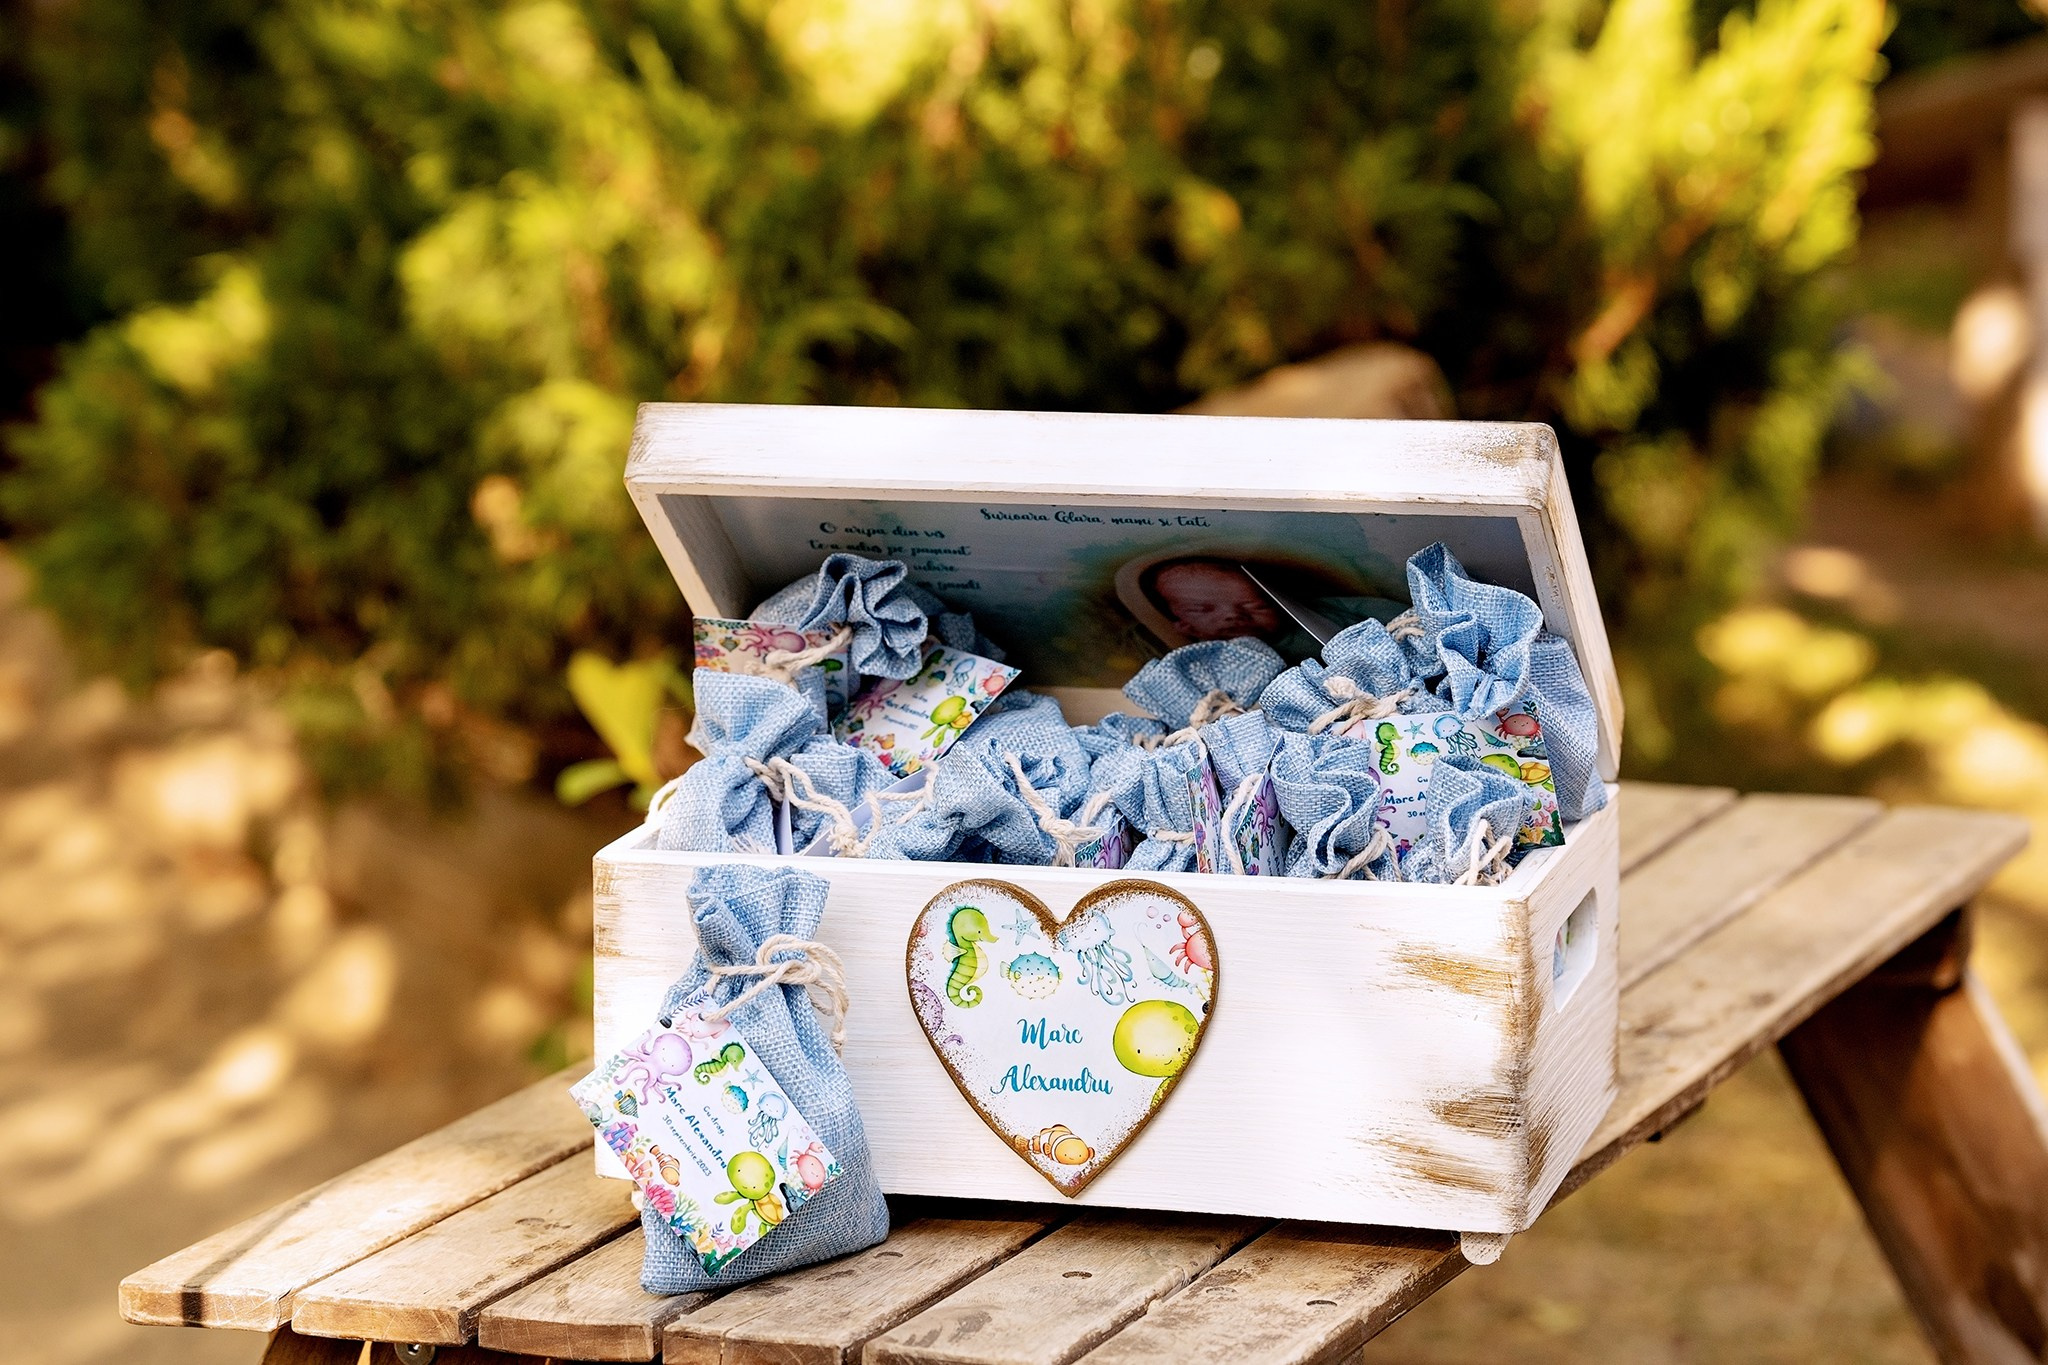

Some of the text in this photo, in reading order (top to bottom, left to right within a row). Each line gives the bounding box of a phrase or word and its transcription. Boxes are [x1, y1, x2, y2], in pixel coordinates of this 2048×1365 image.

[819, 521, 838, 534] O
[892, 525, 919, 537] din
[1111, 516, 1154, 526] mami
[1158, 517, 1173, 527] si
[1174, 516, 1211, 528] tati
[1384, 791, 1427, 806] Marc A
[1407, 810, 1418, 818] 30
[1016, 1018, 1083, 1050] Marc
[989, 1063, 1114, 1095] Alexandru
[664, 1086, 727, 1169] Marc Alexandru
[662, 1114, 712, 1177] 30 septembrie 2023
